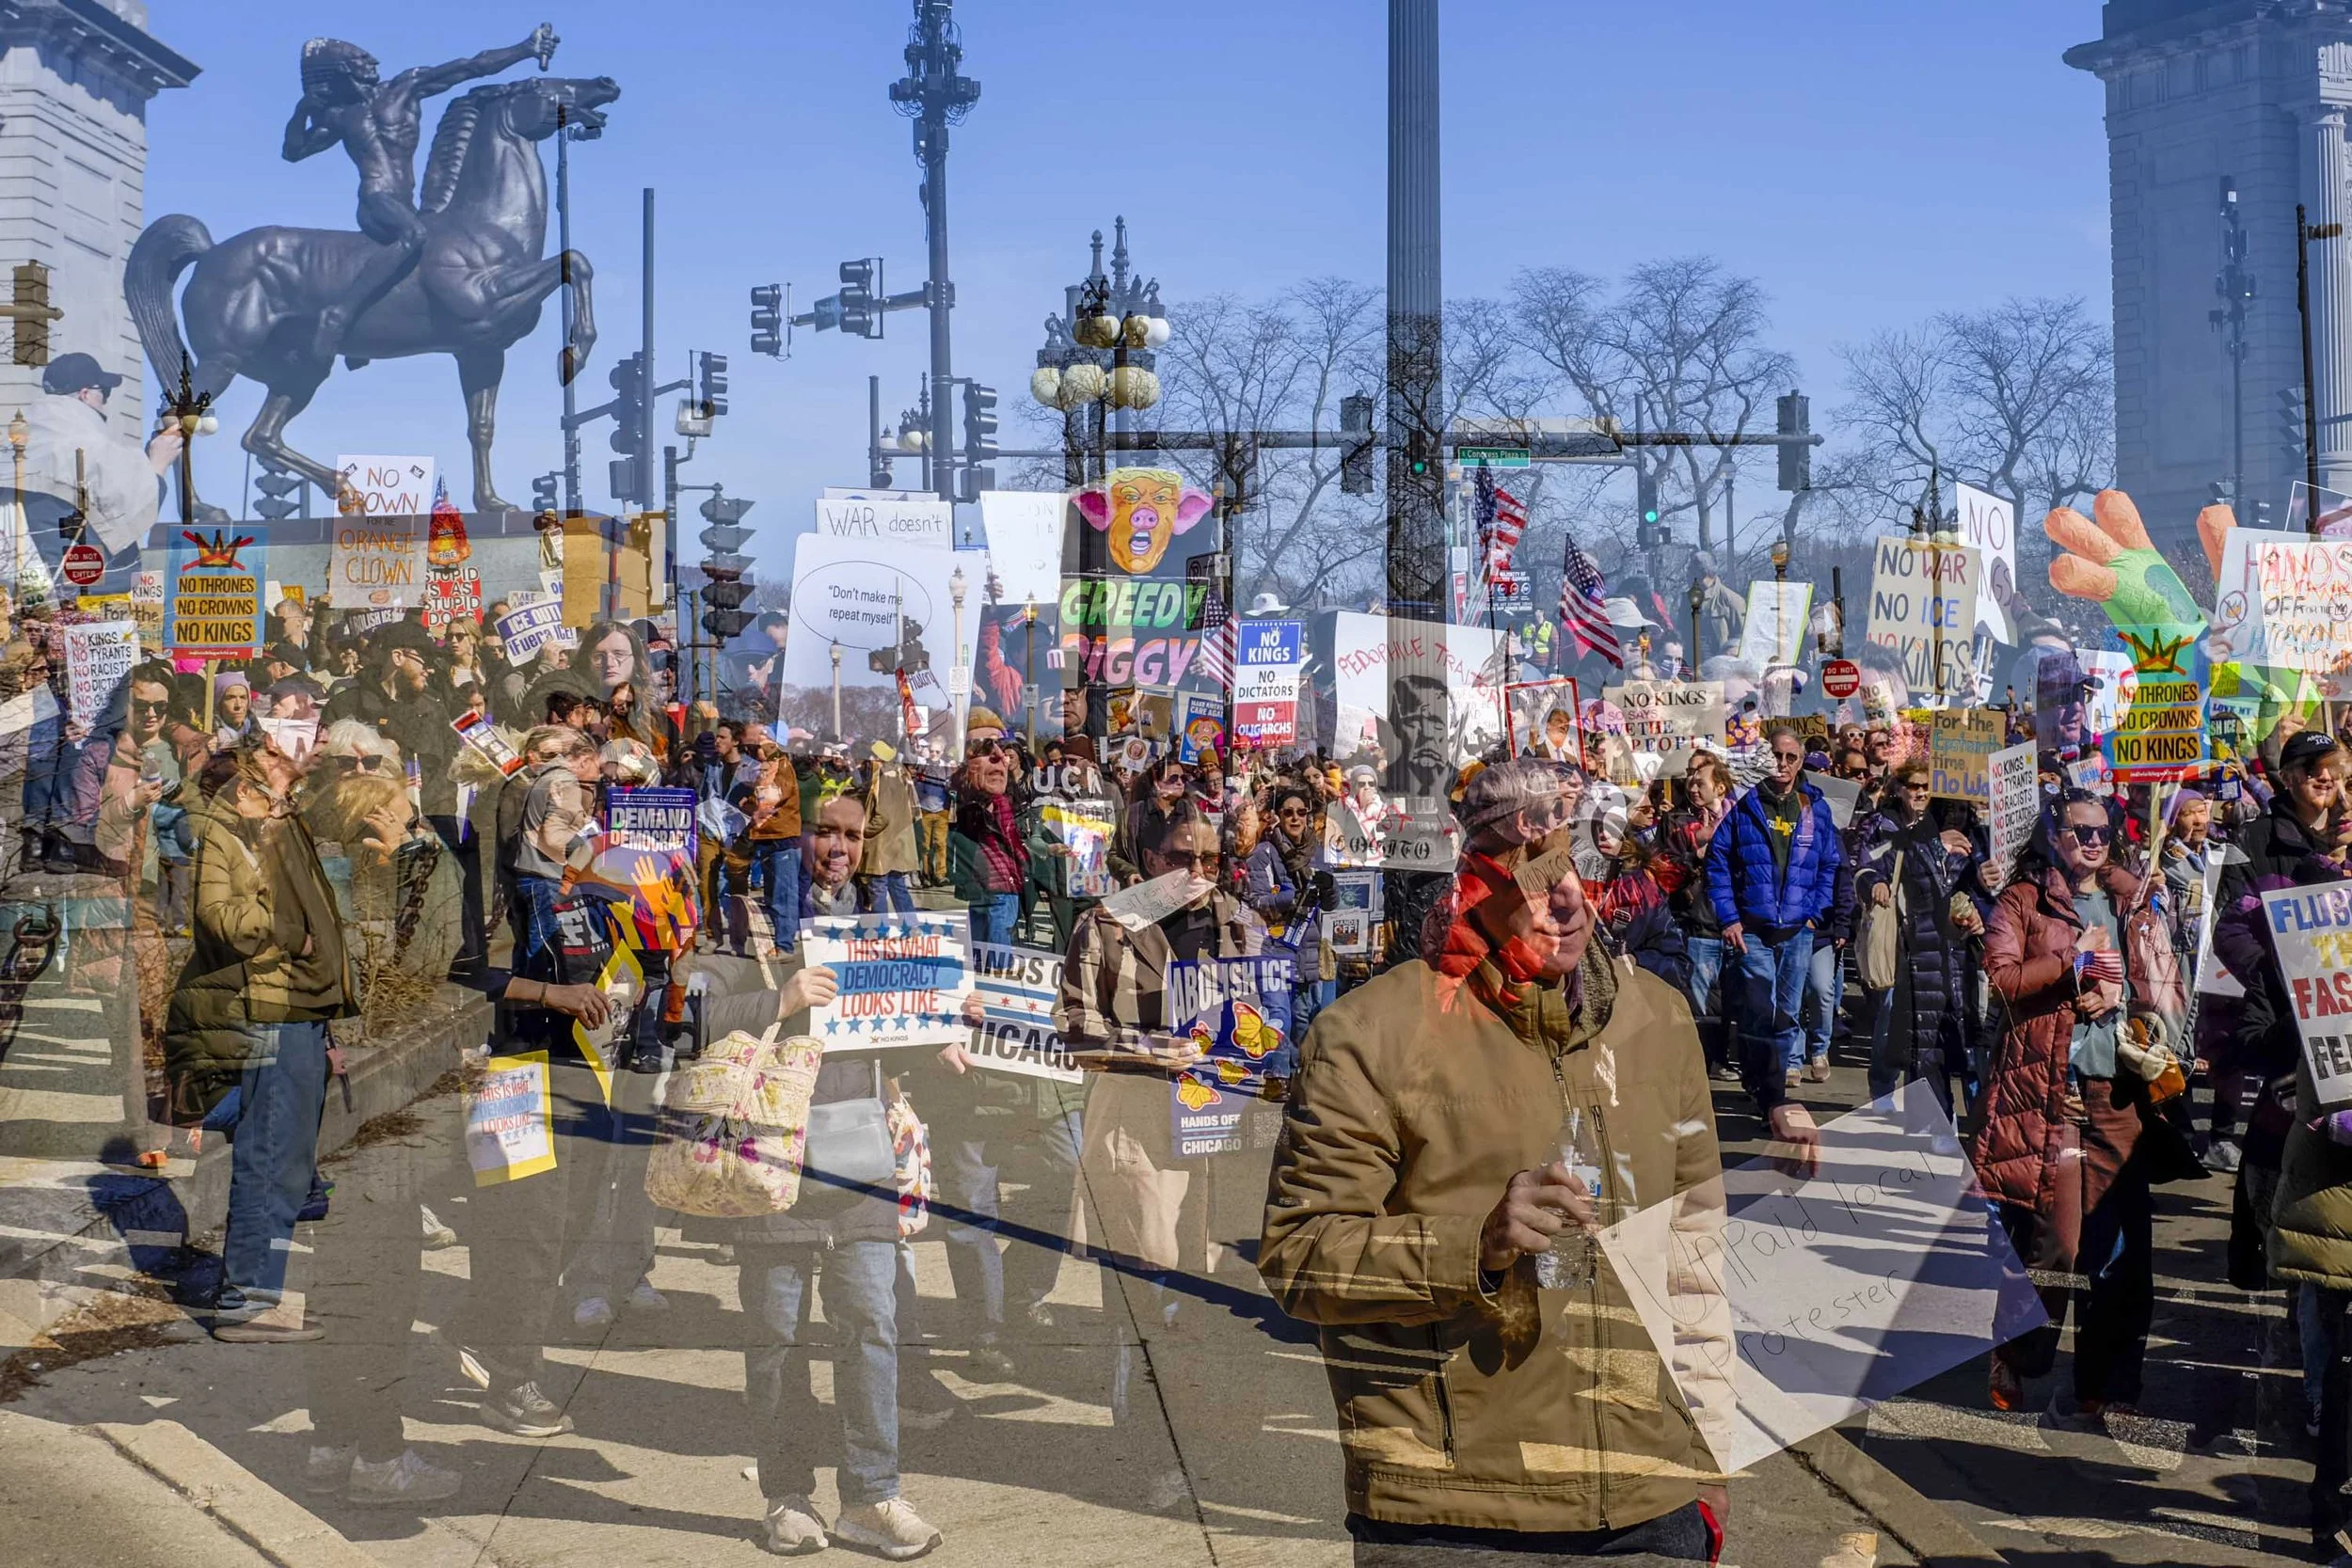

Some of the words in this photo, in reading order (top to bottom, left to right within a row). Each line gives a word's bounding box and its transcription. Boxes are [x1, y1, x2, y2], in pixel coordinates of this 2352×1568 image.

[1468, 451, 1498, 459] Congress
[367, 467, 400, 488] NO
[339, 489, 419, 514] CROWN
[826, 507, 879, 537] WAR
[888, 512, 942, 532] doesn't
[1968, 497, 2006, 551] NO
[340, 530, 418, 554] ORANGE
[346, 557, 412, 585] CLOWN
[1880, 544, 1914, 577] NO
[1921, 548, 1966, 585] WAR
[140, 576, 154, 585] NO
[179, 578, 197, 594] NO
[199, 578, 254, 594] THRONES
[452, 582, 472, 595] AS
[133, 586, 163, 599] KINGS
[861, 592, 886, 604] make
[888, 595, 903, 606] me
[178, 600, 196, 615] NO
[199, 599, 253, 615] CROWNS
[424, 597, 481, 611] STUPID
[1061, 581, 1207, 629] GREEDY
[1874, 592, 1909, 622] NO
[1921, 595, 1960, 628] ICE
[381, 610, 391, 623] ICE
[506, 611, 532, 635] ICE
[829, 609, 860, 621] repeat
[71, 634, 86, 647] NO
[87, 631, 119, 646] KINGS
[177, 623, 199, 642] NO
[204, 623, 252, 642] KINGS
[1261, 632, 1279, 647] NO
[72, 649, 87, 662] NO
[89, 645, 132, 660] TYRANTS
[1248, 646, 1290, 663] KINGS
[1337, 637, 1425, 680] PEDOPHILE
[74, 665, 89, 678] NO
[1258, 671, 1276, 684] NO
[75, 681, 91, 694] NO
[1238, 685, 1293, 698] DICTATORS
[1516, 686, 1567, 705] TYRANT
[1860, 686, 1880, 698] NO
[2117, 686, 2135, 704] NO
[2139, 684, 2198, 704] THRONES
[77, 696, 92, 708] NO
[1624, 693, 1649, 708] NO
[1655, 690, 1707, 706] KINGS
[1190, 705, 1207, 715] CARE
[1256, 707, 1275, 721] NO
[1629, 709, 1657, 721] SAYS
[2117, 712, 2136, 730] NO
[2140, 709, 2198, 730] CROWNS
[1237, 722, 1292, 736] OLIGARCHS
[1638, 721, 1674, 735] THE
[1935, 711, 1961, 729] For
[1968, 714, 1994, 733] the
[1631, 734, 1715, 752] PEOPLE
[2117, 738, 2141, 762] NO
[2146, 736, 2198, 761] KINGS
[1993, 763, 2003, 779] NO
[2003, 755, 2024, 775] KINGS
[1932, 769, 1961, 794] No
[1963, 771, 1990, 796] Wa
[1993, 780, 2004, 796] NO
[2004, 769, 2033, 790] TYRANTS
[1993, 798, 2004, 813] NO
[2004, 787, 2033, 811] RACISTS
[611, 807, 692, 829] DEMAND
[1994, 816, 2005, 831] NO
[2005, 804, 2036, 828] DICTATORS
[611, 830, 691, 852] DEMOCRACY
[1994, 832, 2005, 848] NO
[1994, 851, 2005, 865] NO
[845, 939, 879, 963] THIS
[882, 937, 898, 961] IS
[900, 935, 941, 959] WHAT
[844, 961, 939, 990] DEMOCRACY
[973, 947, 1043, 986] ANDS
[841, 991, 895, 1018] LOOKS
[900, 990, 939, 1014] LIKE
[1172, 961, 1257, 1034] ABOLISH
[1262, 959, 1293, 992] ICE
[2292, 971, 2352, 1020] FAS
[479, 1087, 501, 1102] THIS
[502, 1084, 511, 1099] IS
[512, 1080, 529, 1095] WHAT
[482, 1116, 514, 1135] LOOKS
[1181, 1116, 1219, 1129] HANDS
[1220, 1114, 1241, 1127] OFF
[1182, 1138, 1241, 1155] CHICAGO
[1832, 1150, 1934, 1225] local
